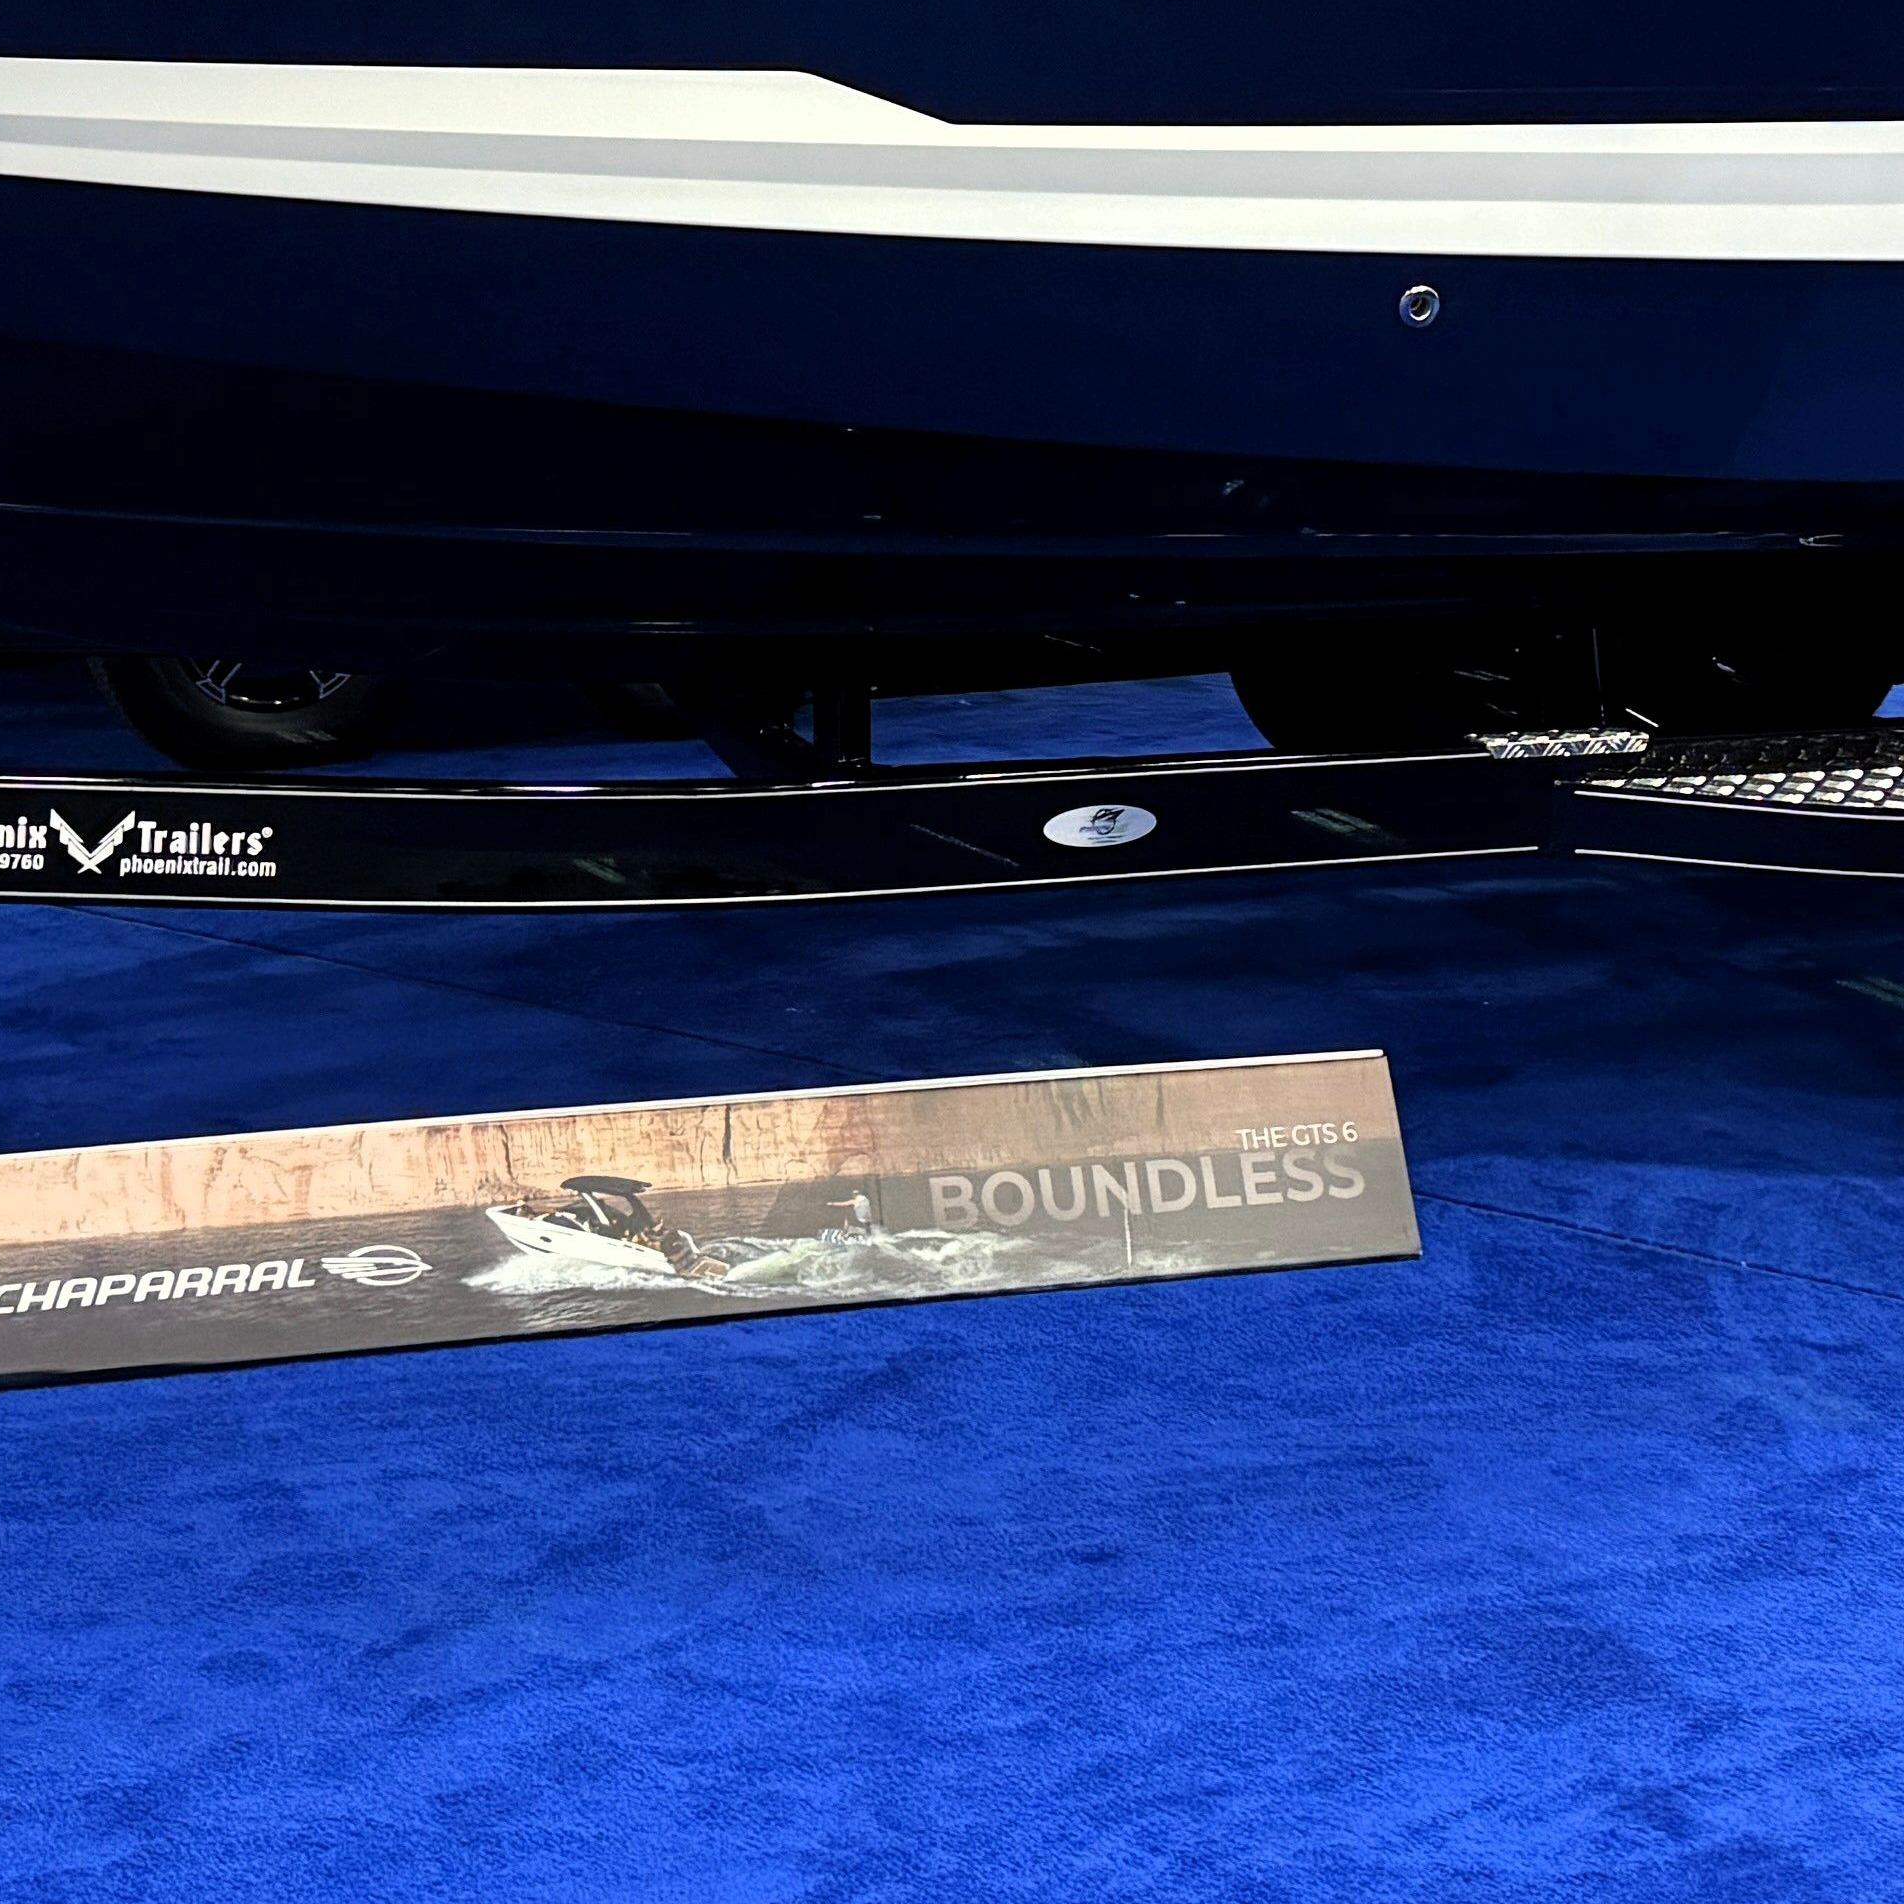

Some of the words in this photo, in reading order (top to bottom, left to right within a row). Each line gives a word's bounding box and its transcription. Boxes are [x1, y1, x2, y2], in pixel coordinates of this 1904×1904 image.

[119, 856, 277, 877] phoenixtrail.com
[1236, 1126, 1287, 1151] THE
[1291, 1123, 1338, 1147] GTS
[1341, 1120, 1359, 1143] 6
[928, 1148, 1366, 1232] BOUNDLESS
